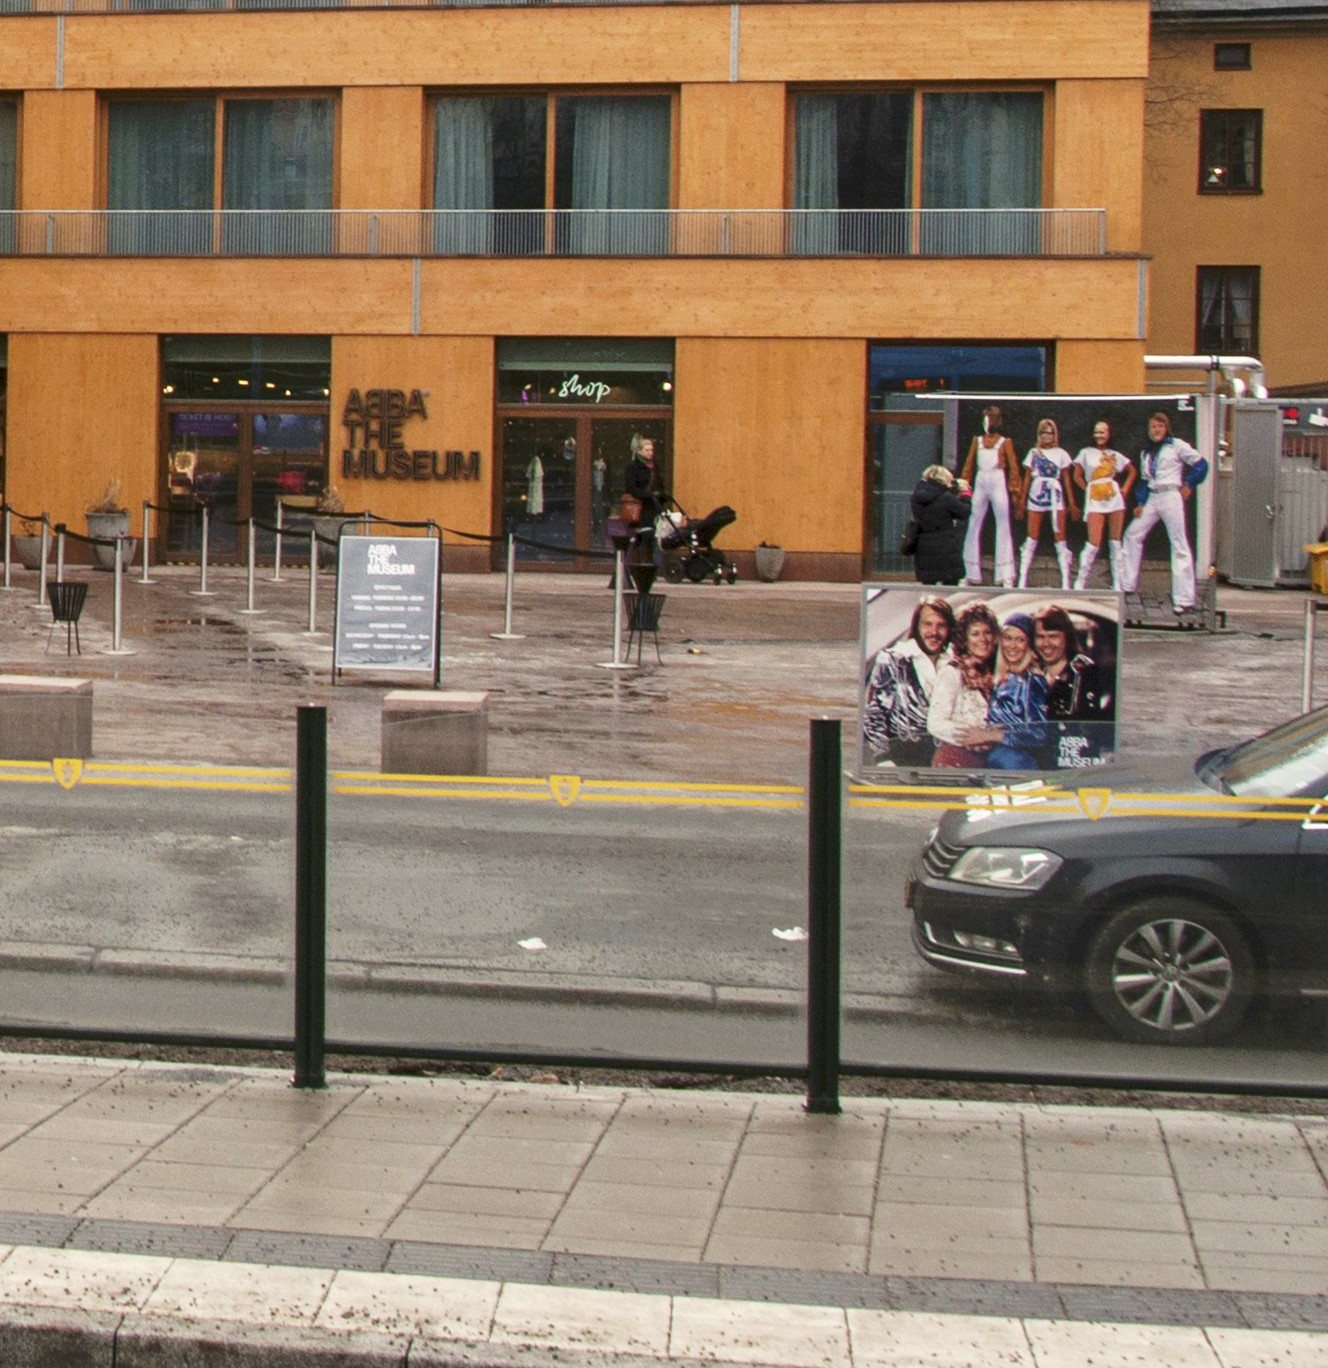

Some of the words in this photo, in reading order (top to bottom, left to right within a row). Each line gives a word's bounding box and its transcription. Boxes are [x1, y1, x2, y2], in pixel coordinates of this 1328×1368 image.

[558, 374, 611, 403] shop
[342, 388, 428, 420] ABBA
[342, 419, 404, 449] THE
[342, 449, 481, 481] MUSEUM
[367, 544, 398, 557] ABBA
[369, 554, 390, 565] THE
[367, 563, 416, 575] MUSEUM
[1058, 736, 1089, 748] ABBA
[1060, 746, 1081, 758] THE
[1057, 756, 1107, 768] MUSEUM
